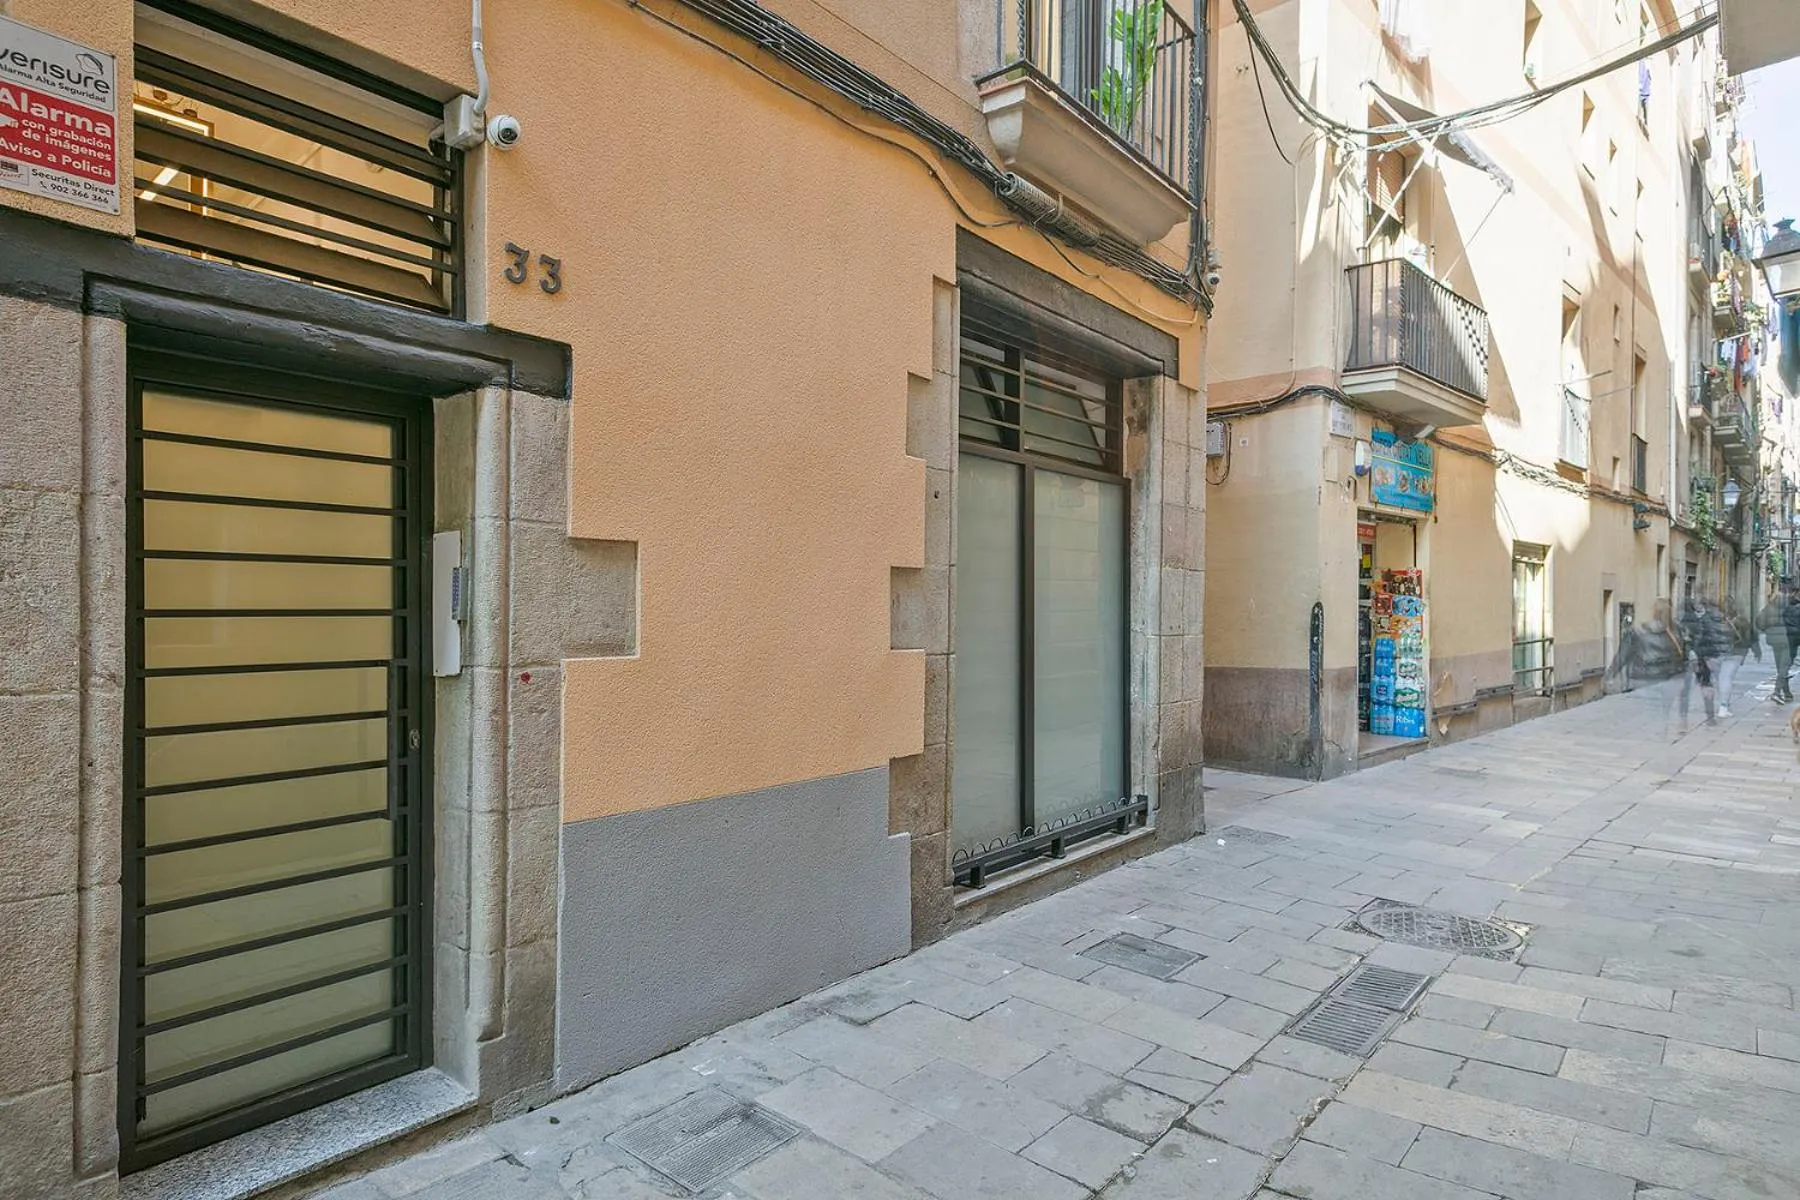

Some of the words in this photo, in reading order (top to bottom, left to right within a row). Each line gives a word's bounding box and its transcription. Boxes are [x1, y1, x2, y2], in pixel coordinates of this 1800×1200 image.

[36, 75, 56, 87] Alta
[58, 82, 106, 102] Seguridad
[0, 87, 112, 138] Alarma
[22, 119, 46, 132] con
[49, 127, 111, 150] grabación
[22, 128, 41, 141] de
[45, 133, 112, 161] imágenes
[0, 136, 42, 158] Aviso
[47, 153, 57, 163] a
[62, 154, 111, 178] Policía
[32, 168, 81, 188] Securitas
[83, 182, 115, 197] Direct
[50, 183, 69, 194] 902
[504, 241, 562, 295] 33
